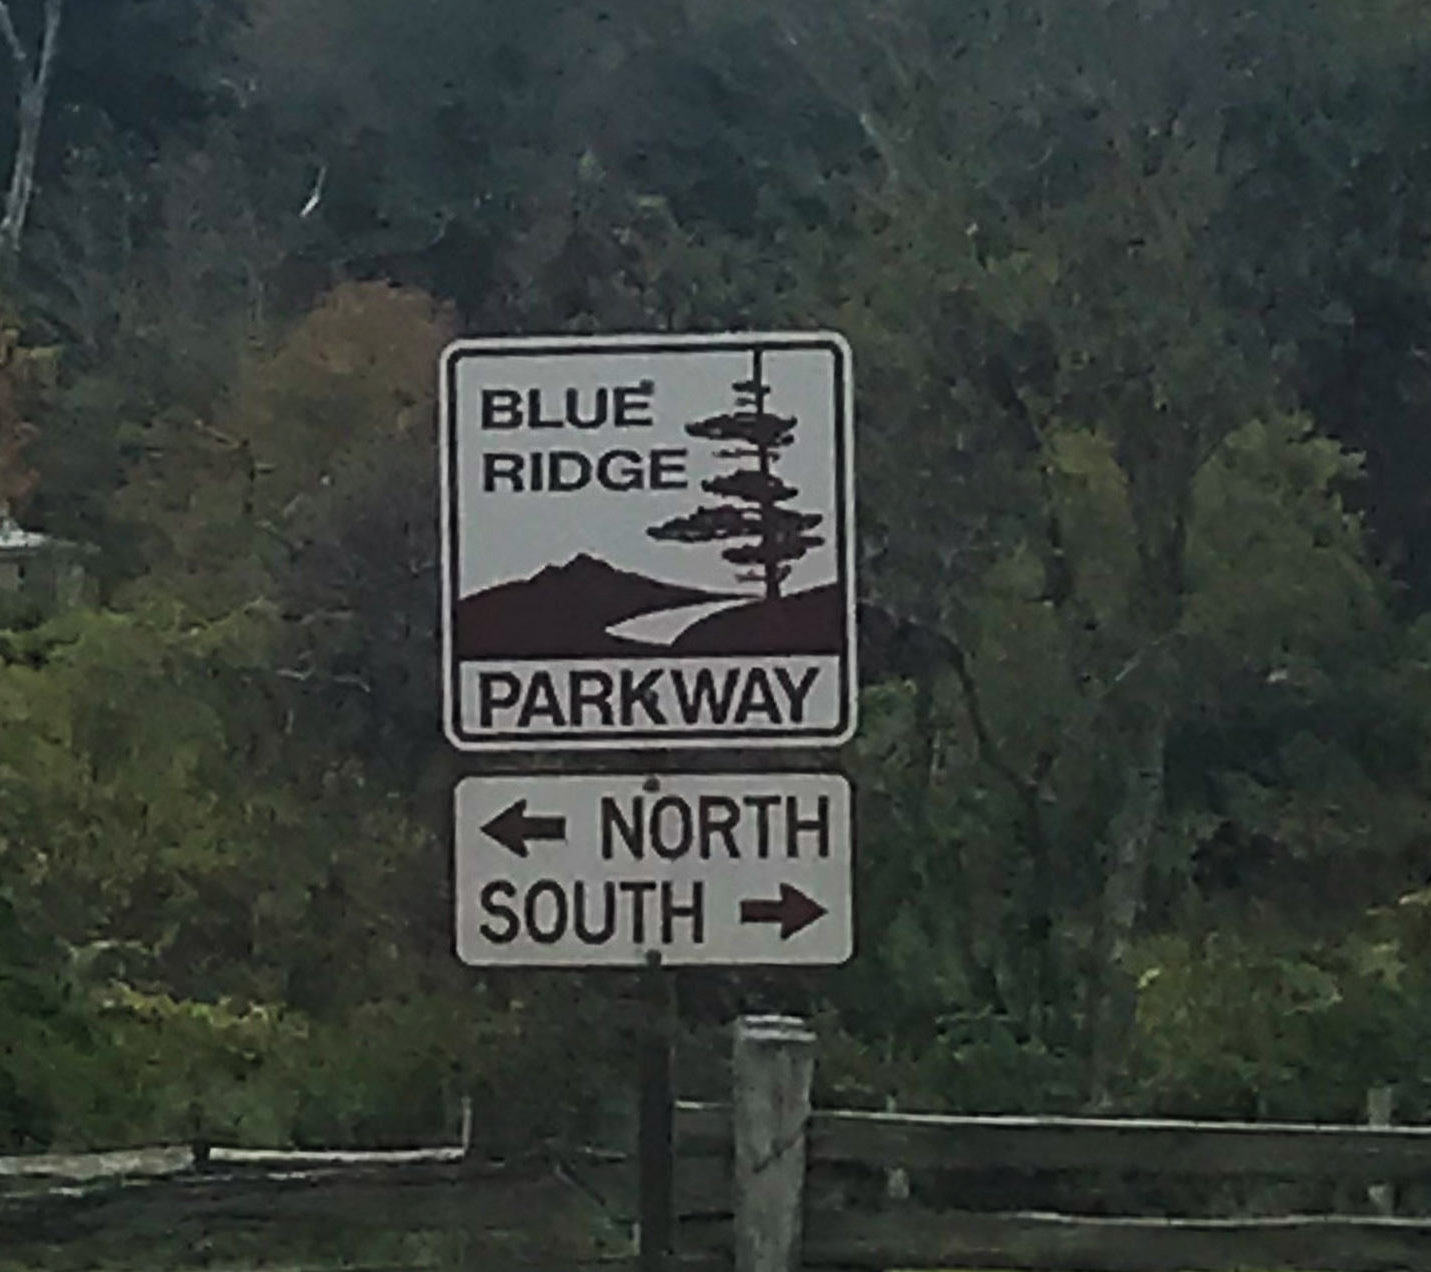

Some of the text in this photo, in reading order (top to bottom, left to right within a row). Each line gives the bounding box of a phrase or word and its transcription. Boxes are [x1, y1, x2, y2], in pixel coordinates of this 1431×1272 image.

[480, 385, 654, 430] BLUE
[482, 448, 688, 493] RIDGE
[478, 667, 820, 728] PARKWAY
[601, 794, 830, 860] NORTH
[479, 879, 705, 945] SOUTH
